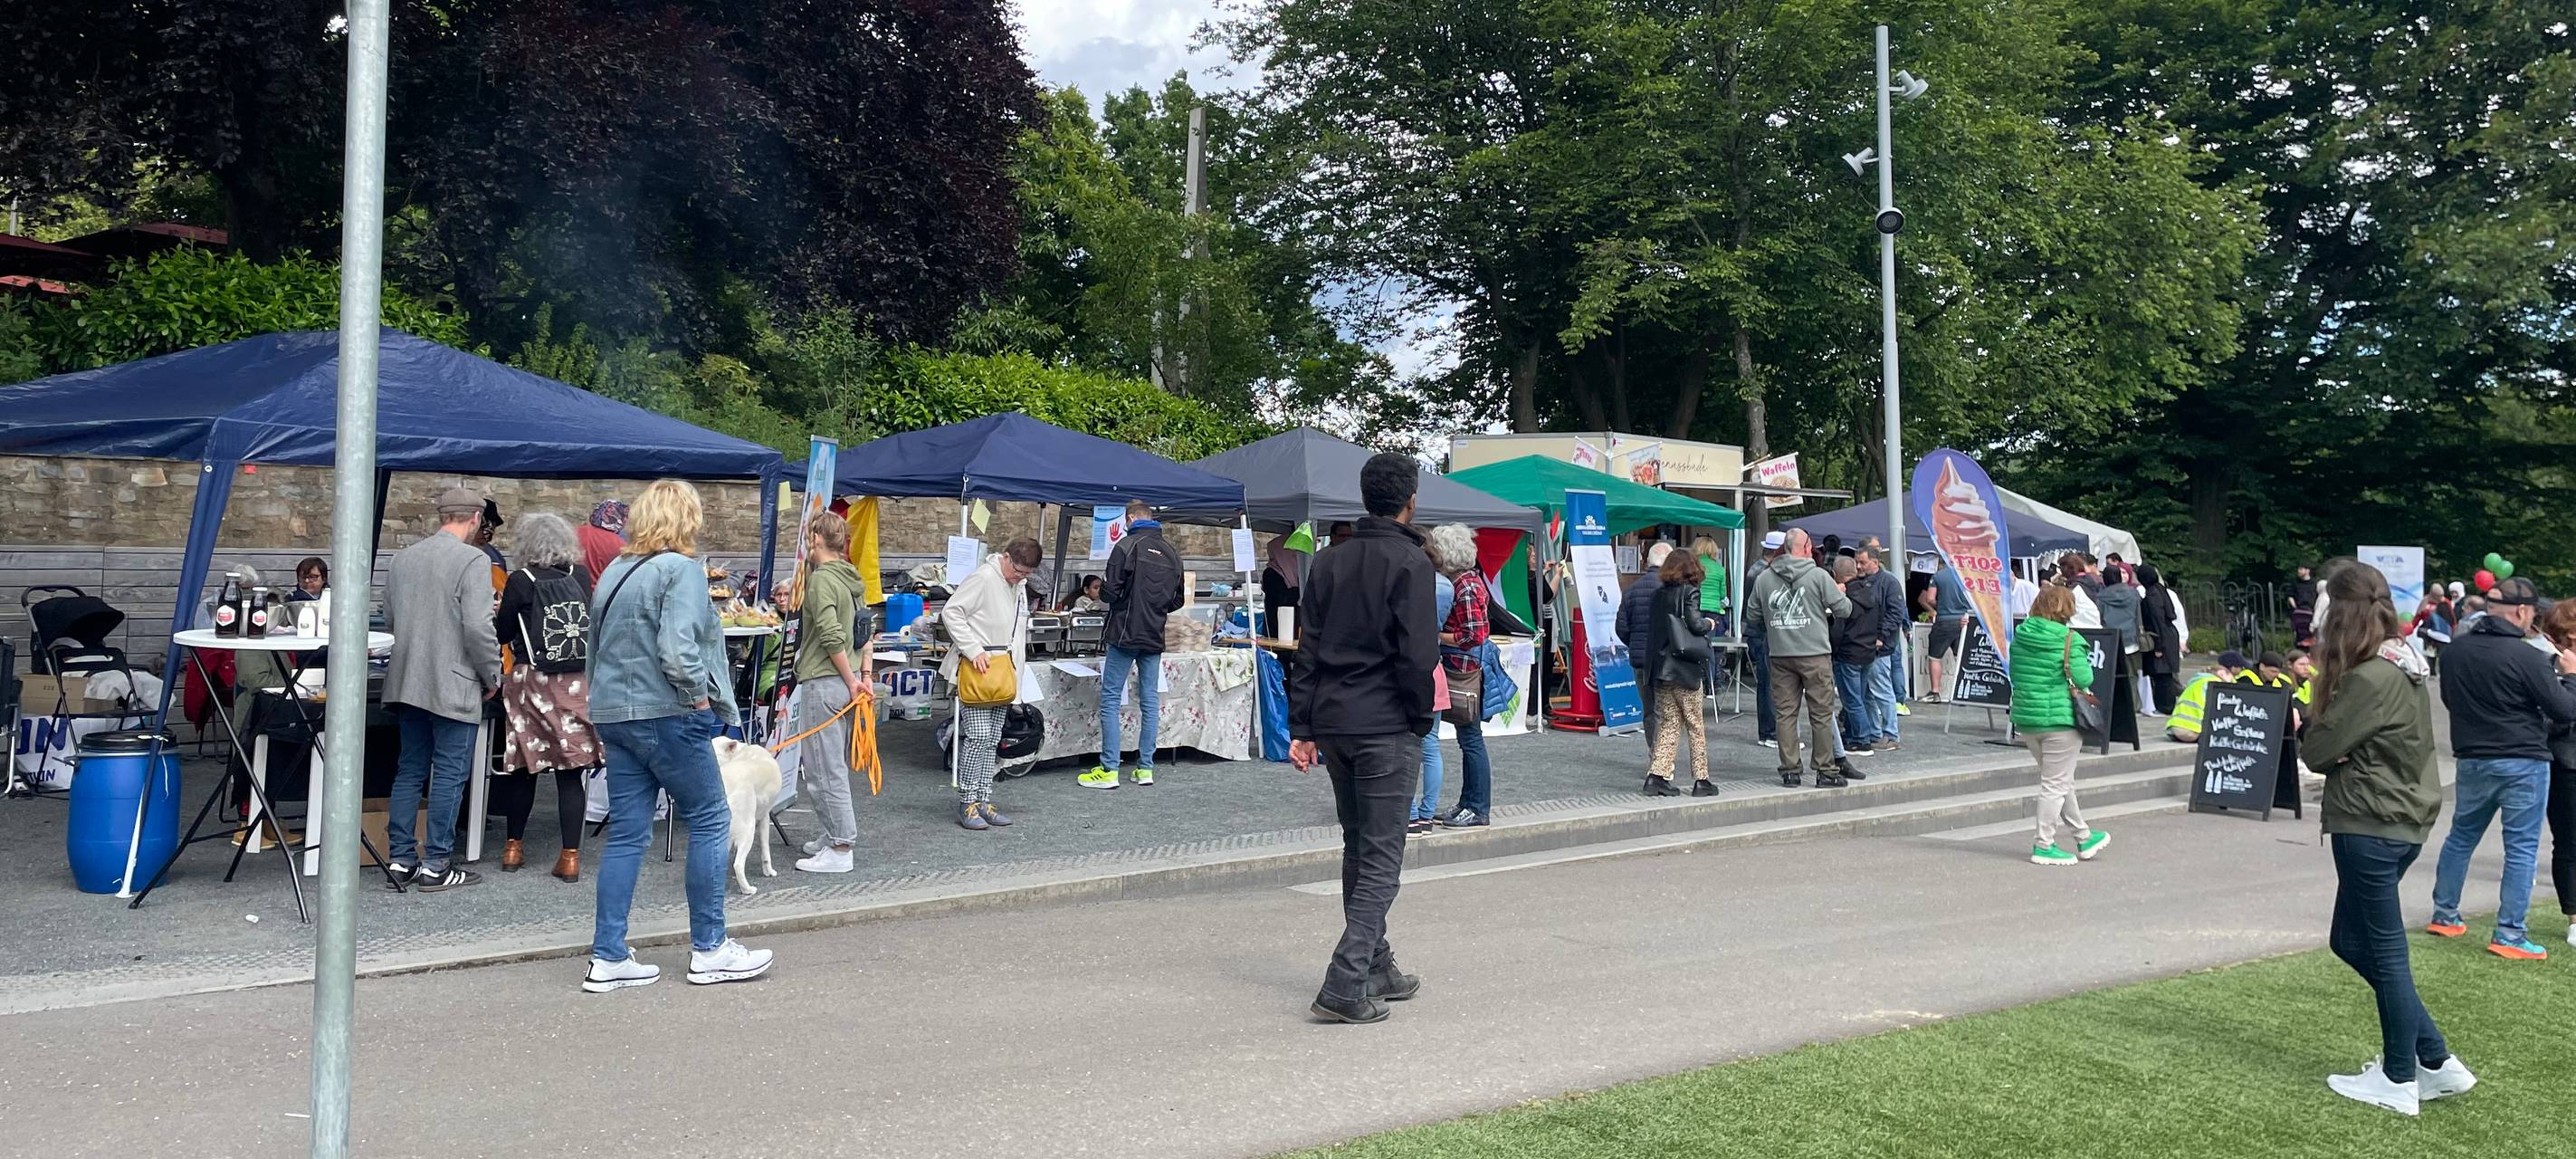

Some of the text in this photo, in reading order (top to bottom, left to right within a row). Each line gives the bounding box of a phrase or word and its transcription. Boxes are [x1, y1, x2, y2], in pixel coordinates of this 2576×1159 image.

[1660, 453, 1708, 475] enussbude
[1761, 462, 1796, 476] Waffeln
[2086, 639, 2105, 669] sh
